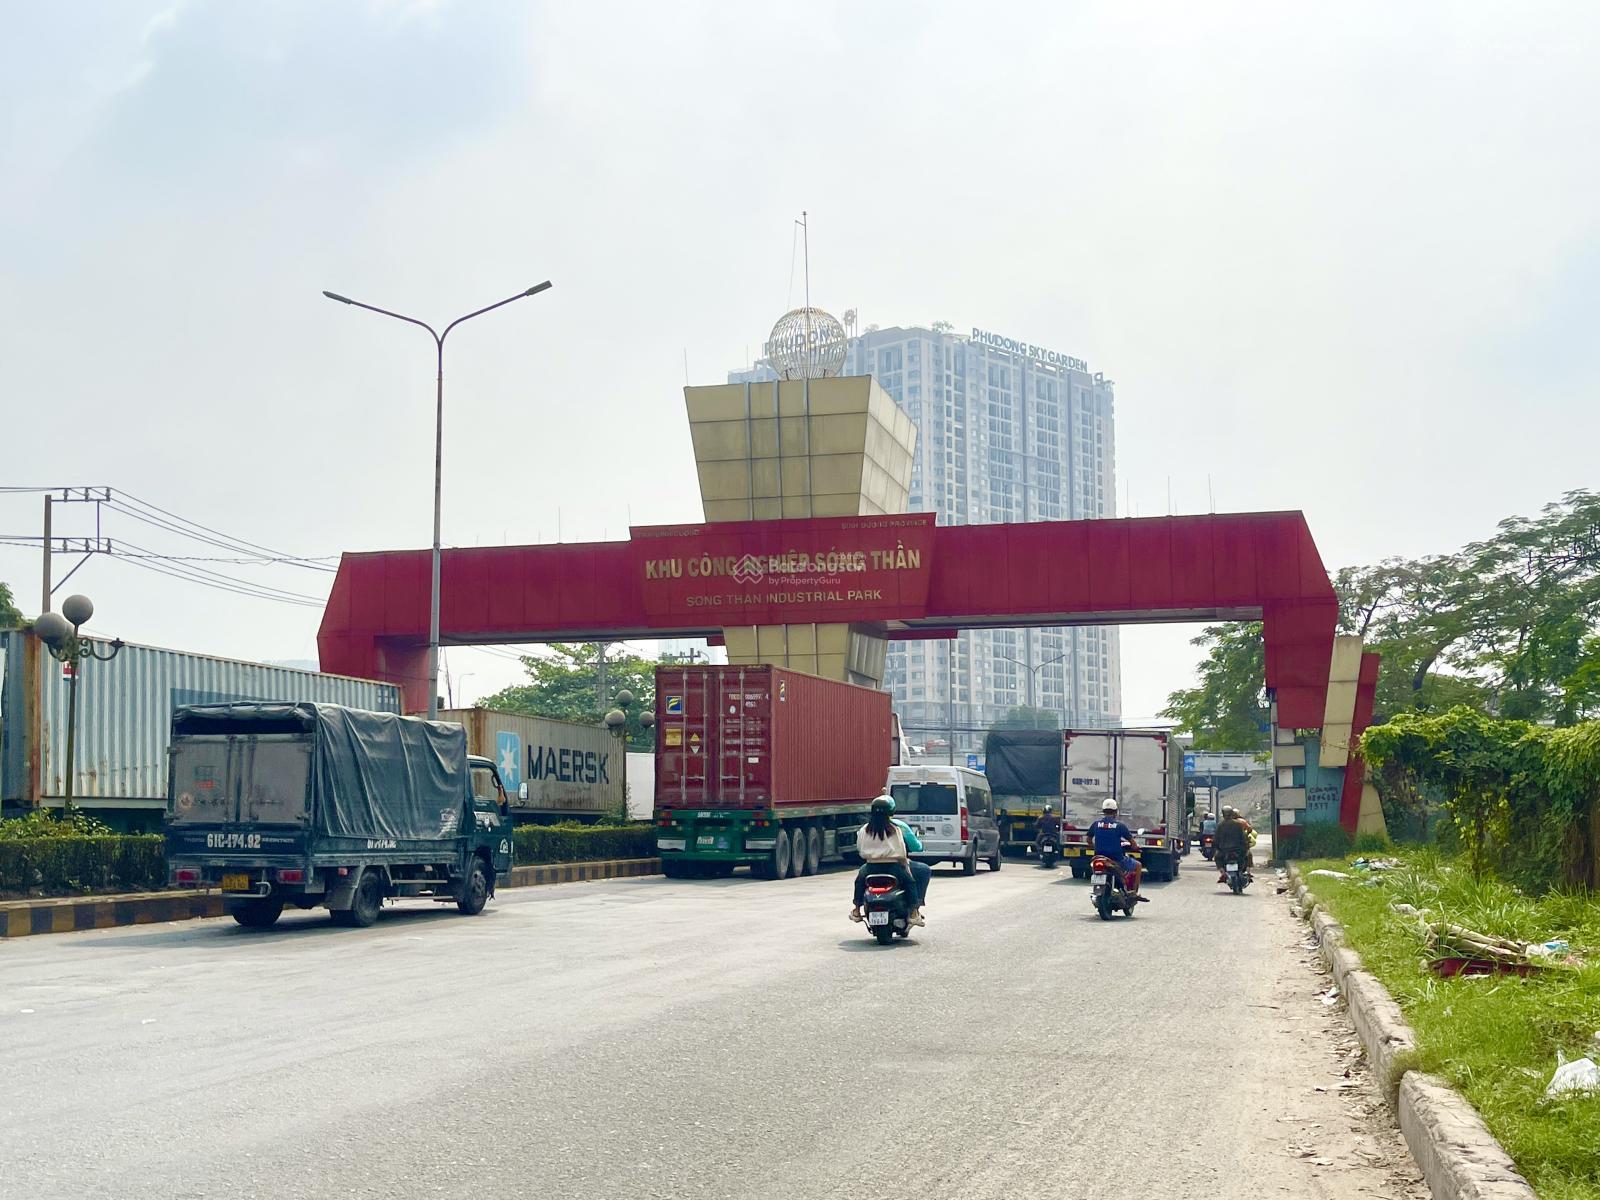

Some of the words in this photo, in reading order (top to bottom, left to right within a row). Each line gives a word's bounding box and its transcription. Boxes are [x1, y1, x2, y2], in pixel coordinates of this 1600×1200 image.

[972, 327, 1027, 355] PHUDONG
[1028, 345, 1047, 360] SKY
[1047, 351, 1088, 373] GARDEN
[645, 558, 683, 579] KHU
[687, 551, 738, 578] CÔNG
[686, 595, 722, 607] SONG
[726, 593, 763, 605] THAN
[766, 591, 844, 603] INDUSTRIAL
[847, 589, 882, 601] PARK
[528, 745, 610, 785] MAERSK
